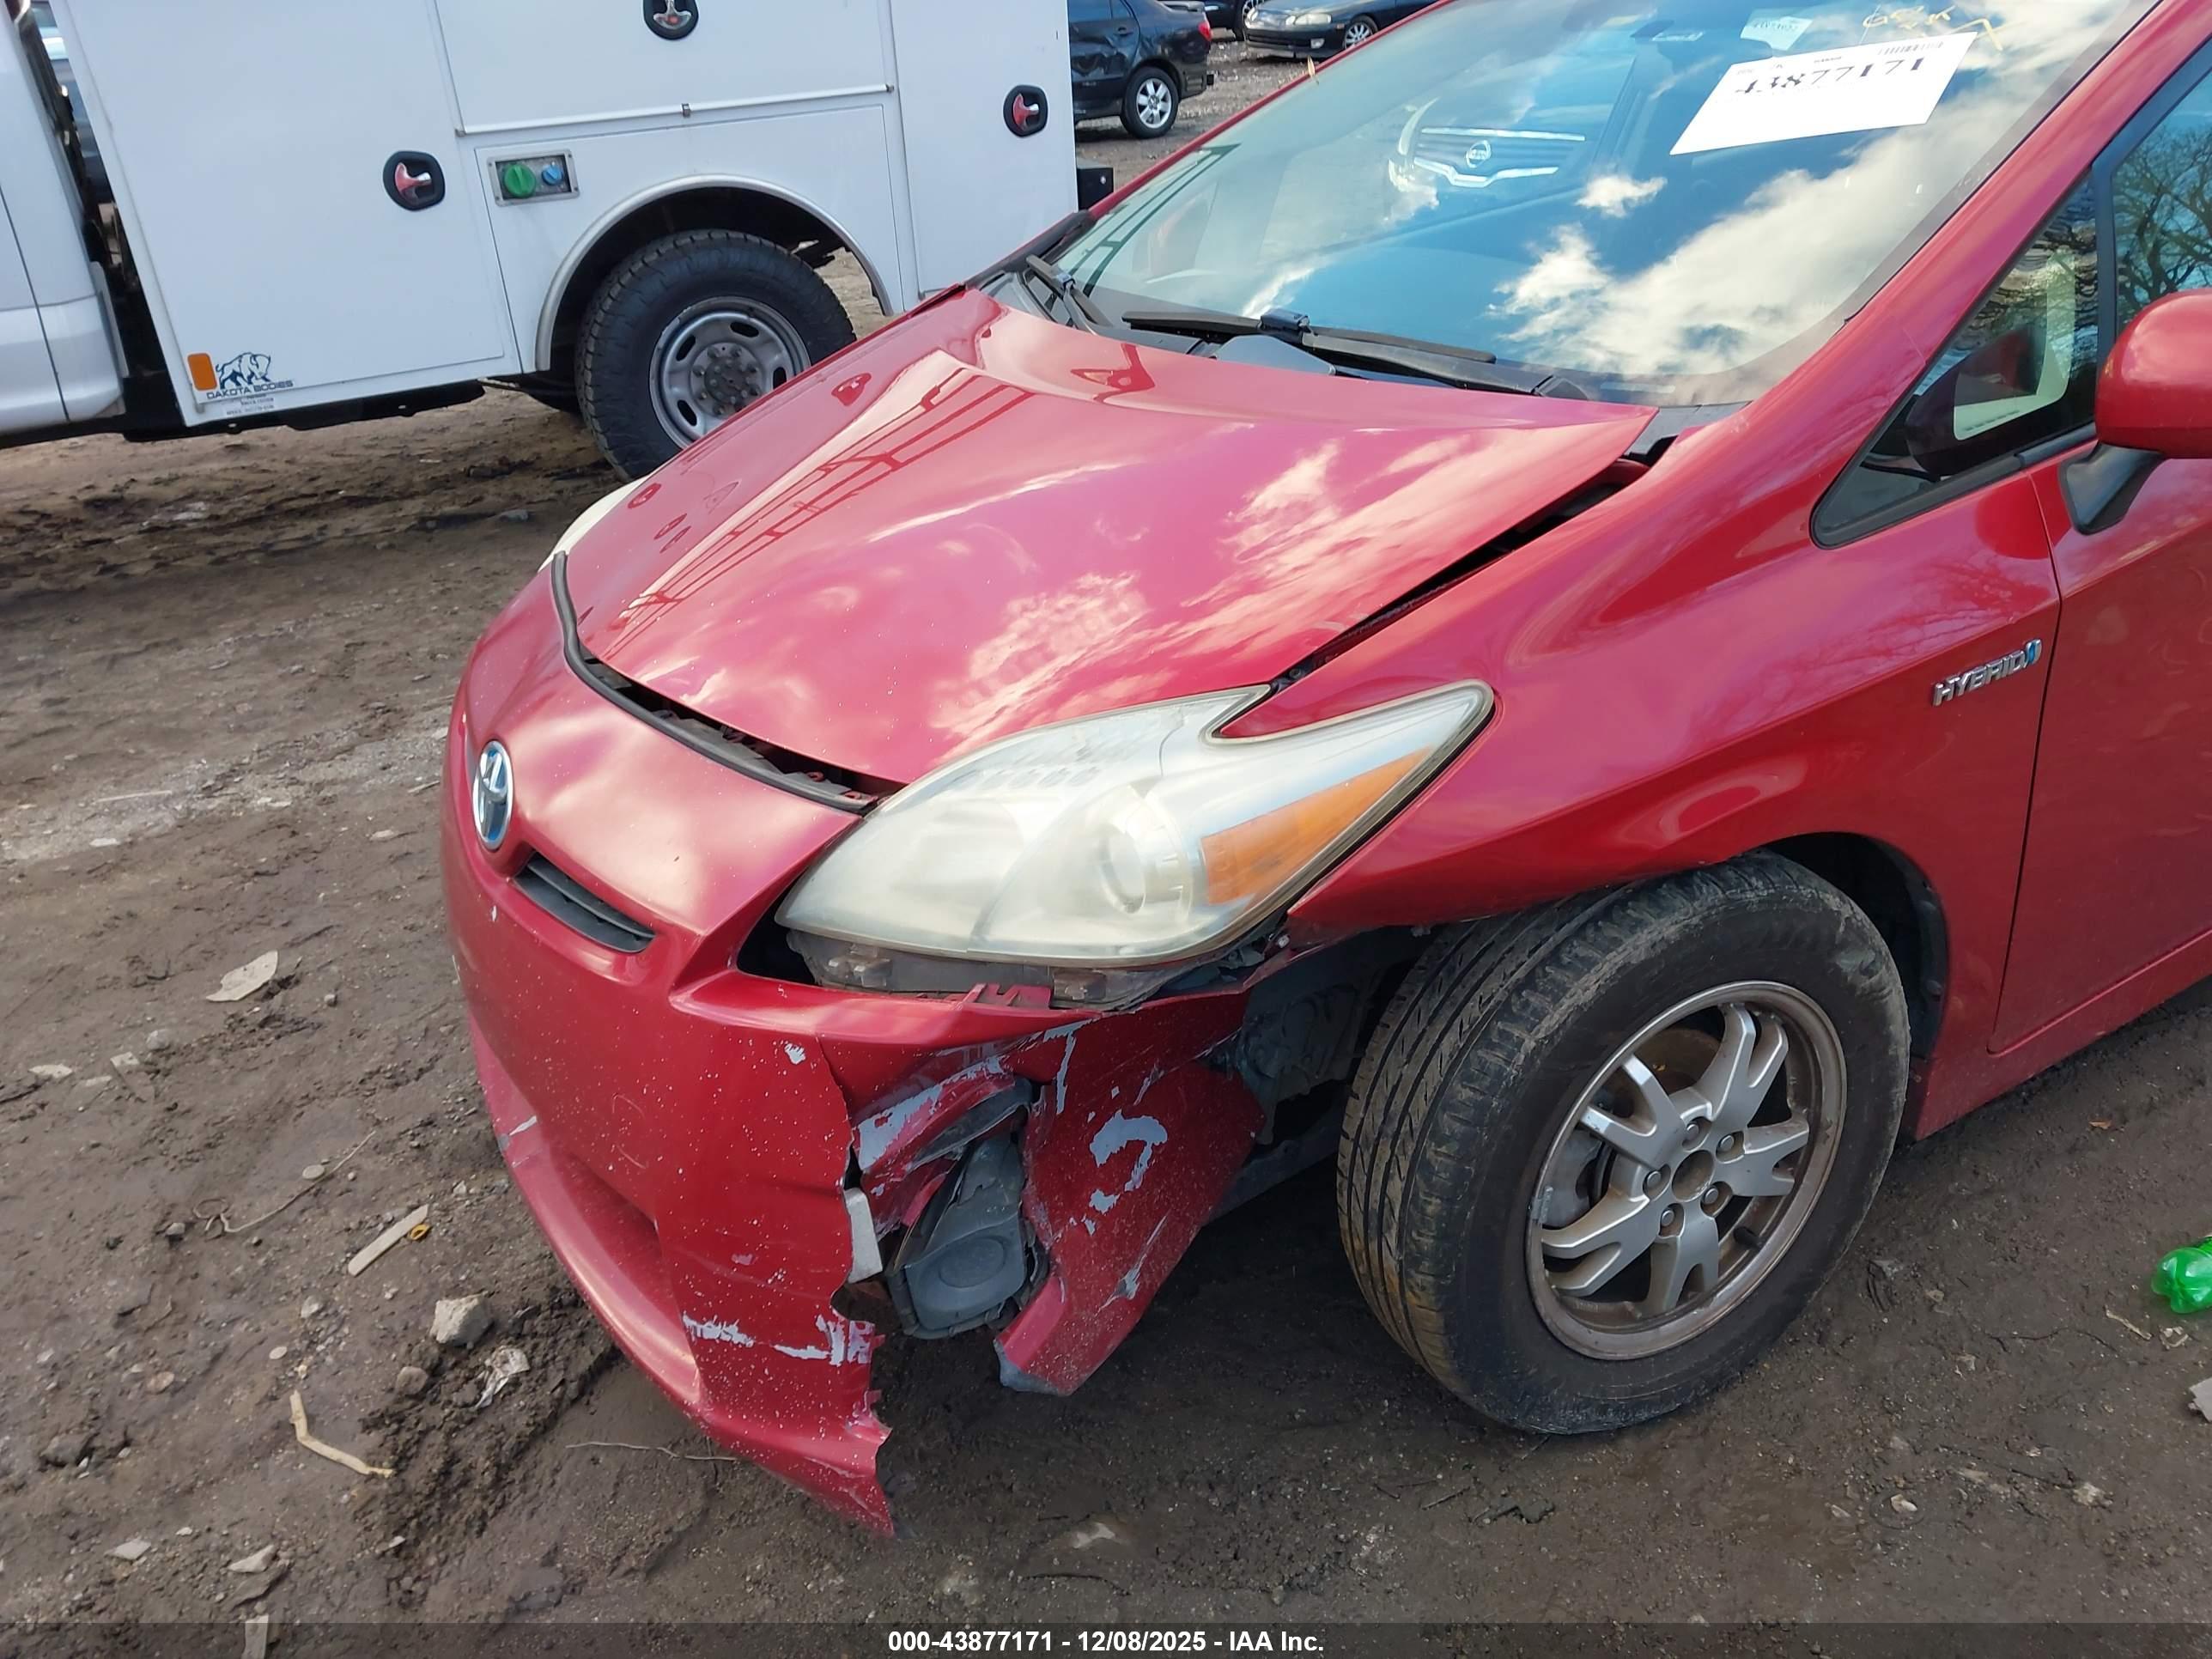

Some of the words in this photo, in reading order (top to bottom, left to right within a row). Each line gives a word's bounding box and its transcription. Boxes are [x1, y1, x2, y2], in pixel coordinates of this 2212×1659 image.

[206, 386, 252, 400] DAKOTA
[253, 380, 294, 392] BODIES
[1933, 650, 2027, 707] HYBRID
